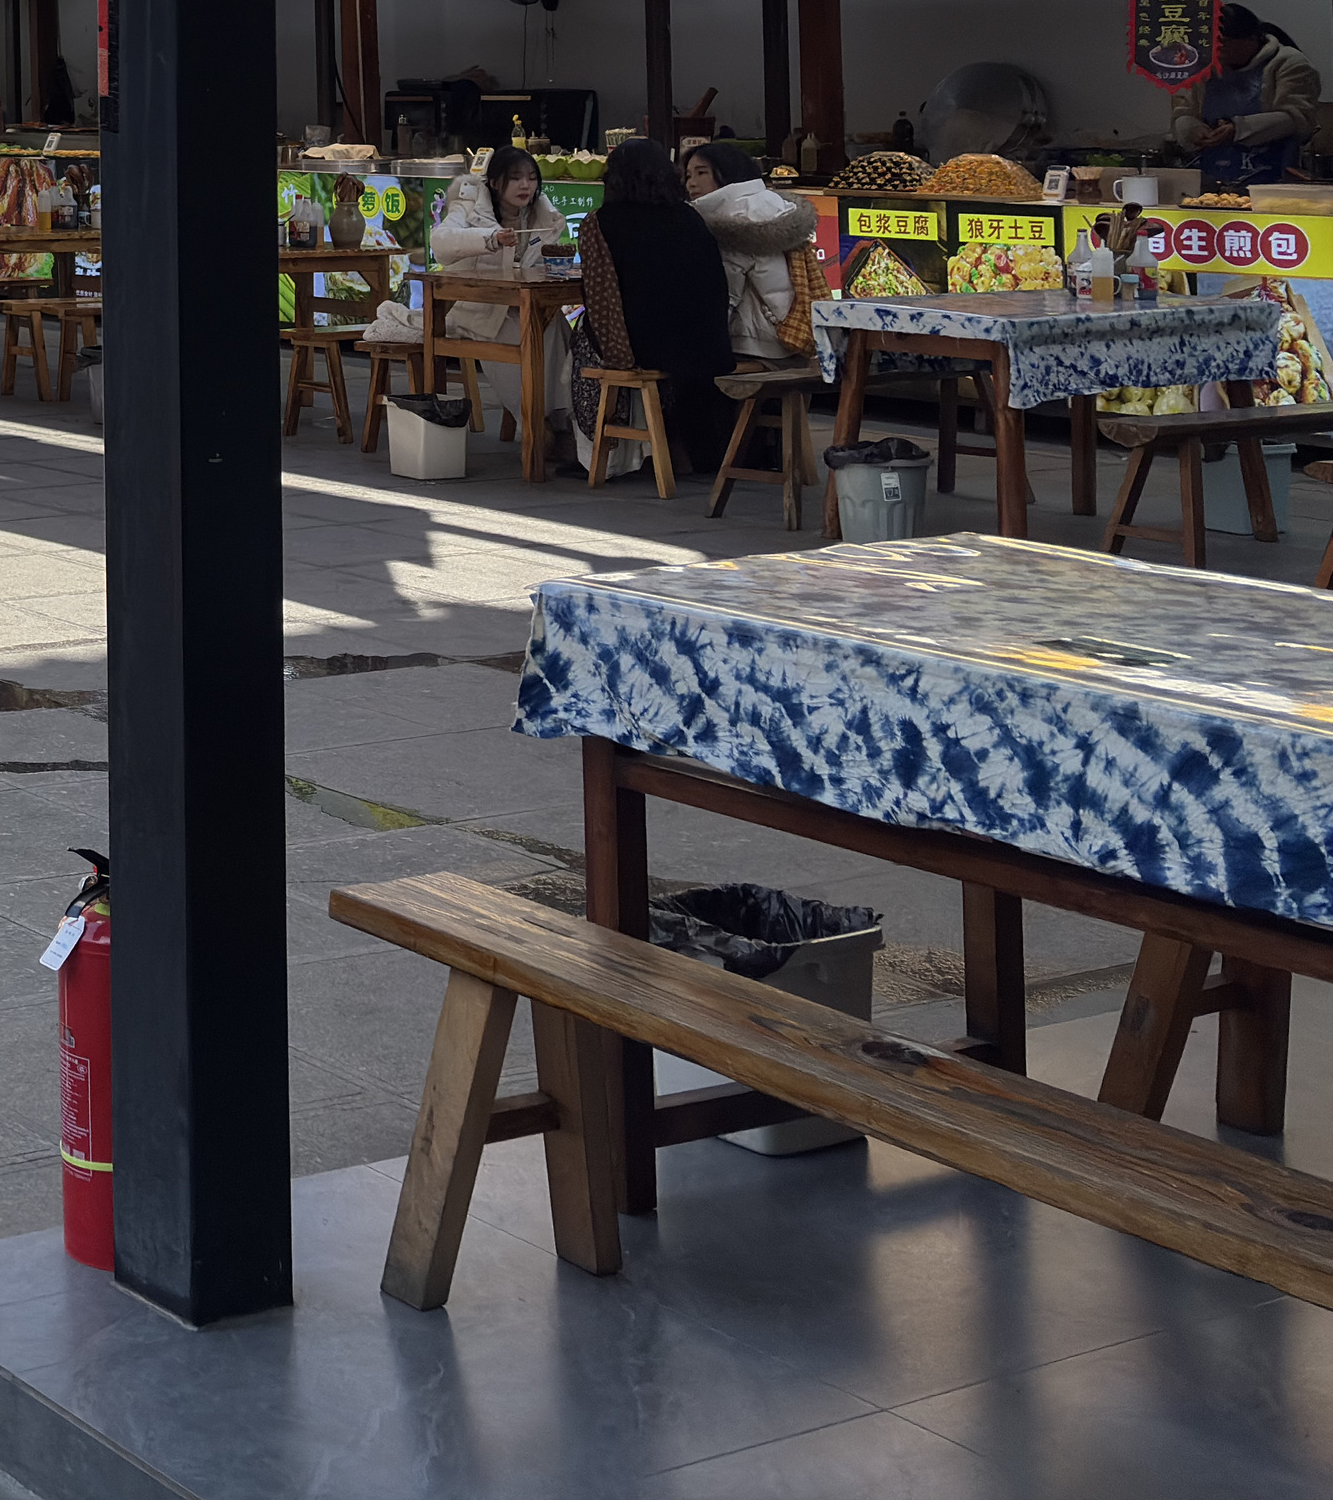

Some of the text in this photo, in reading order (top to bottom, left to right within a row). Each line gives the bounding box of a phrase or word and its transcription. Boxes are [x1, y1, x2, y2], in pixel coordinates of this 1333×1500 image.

[857, 212, 930, 237] 包浆豆腐
[968, 217, 1046, 241] 狼牙土豆
